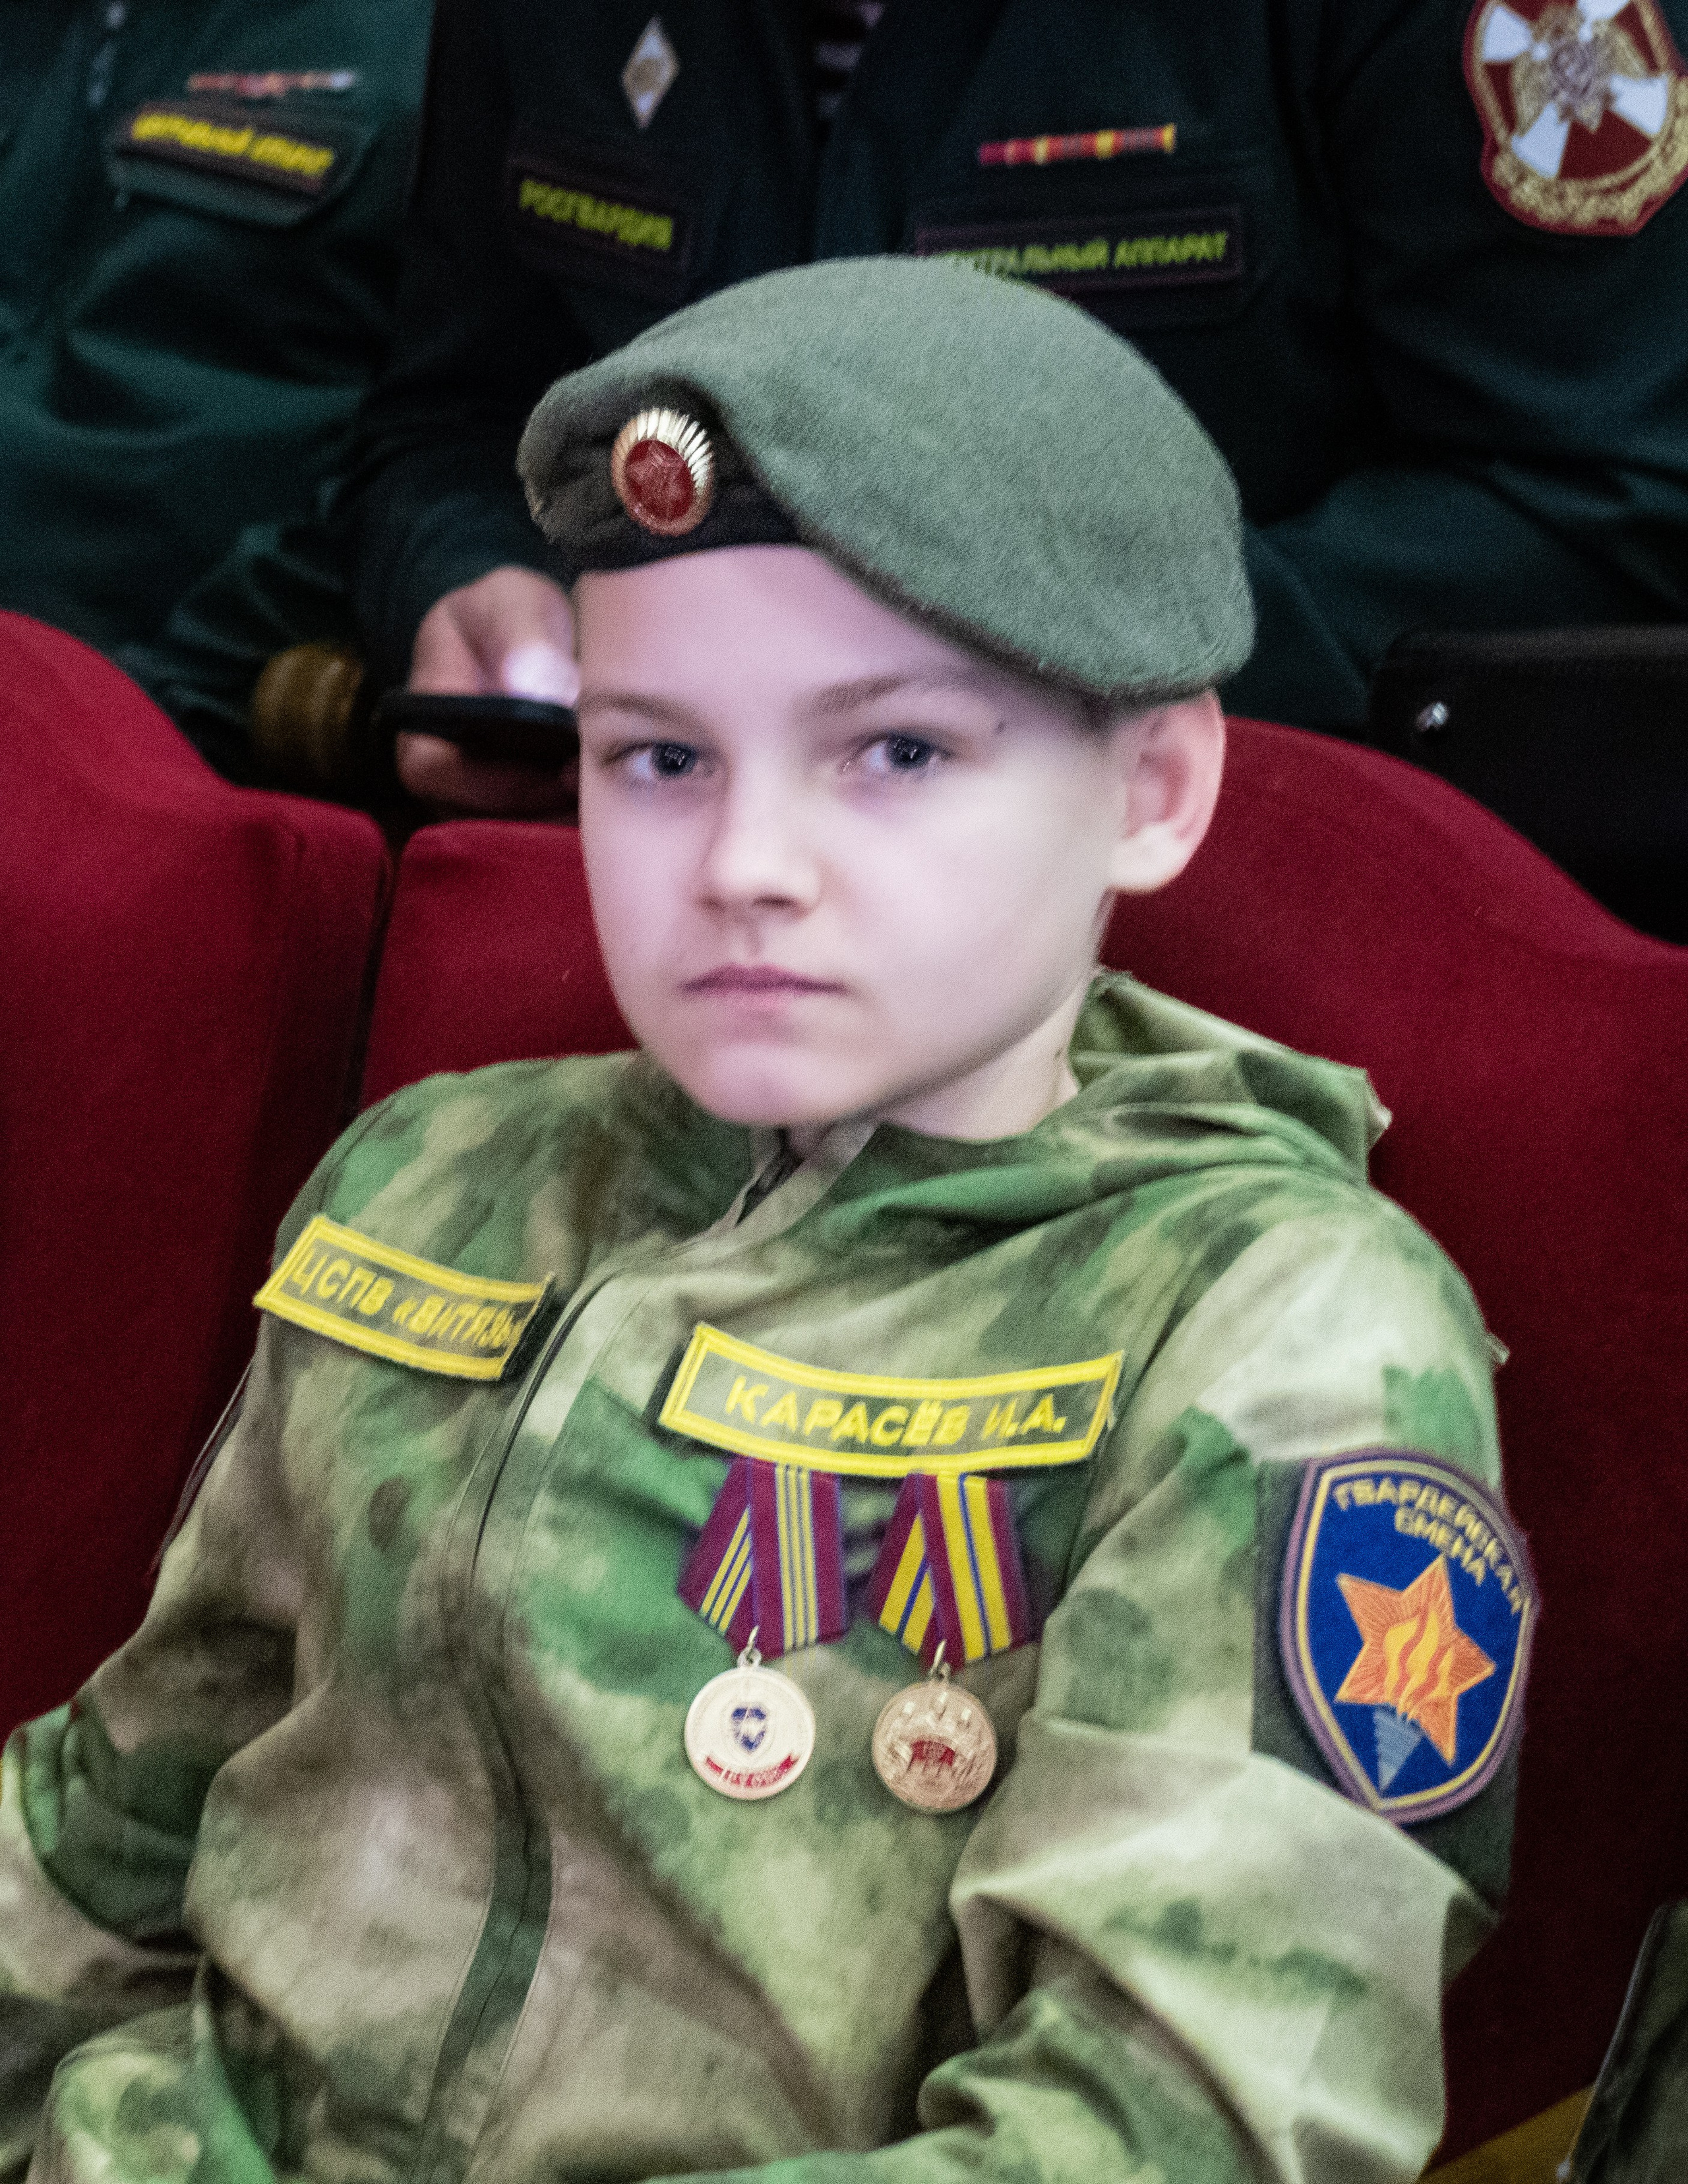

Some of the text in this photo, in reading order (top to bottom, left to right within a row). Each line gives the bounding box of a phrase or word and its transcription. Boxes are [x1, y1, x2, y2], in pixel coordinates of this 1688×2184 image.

[291, 1249, 394, 1315] ЦСПВ
[727, 1378, 1067, 1446] КАРАСЁВ И.А.
